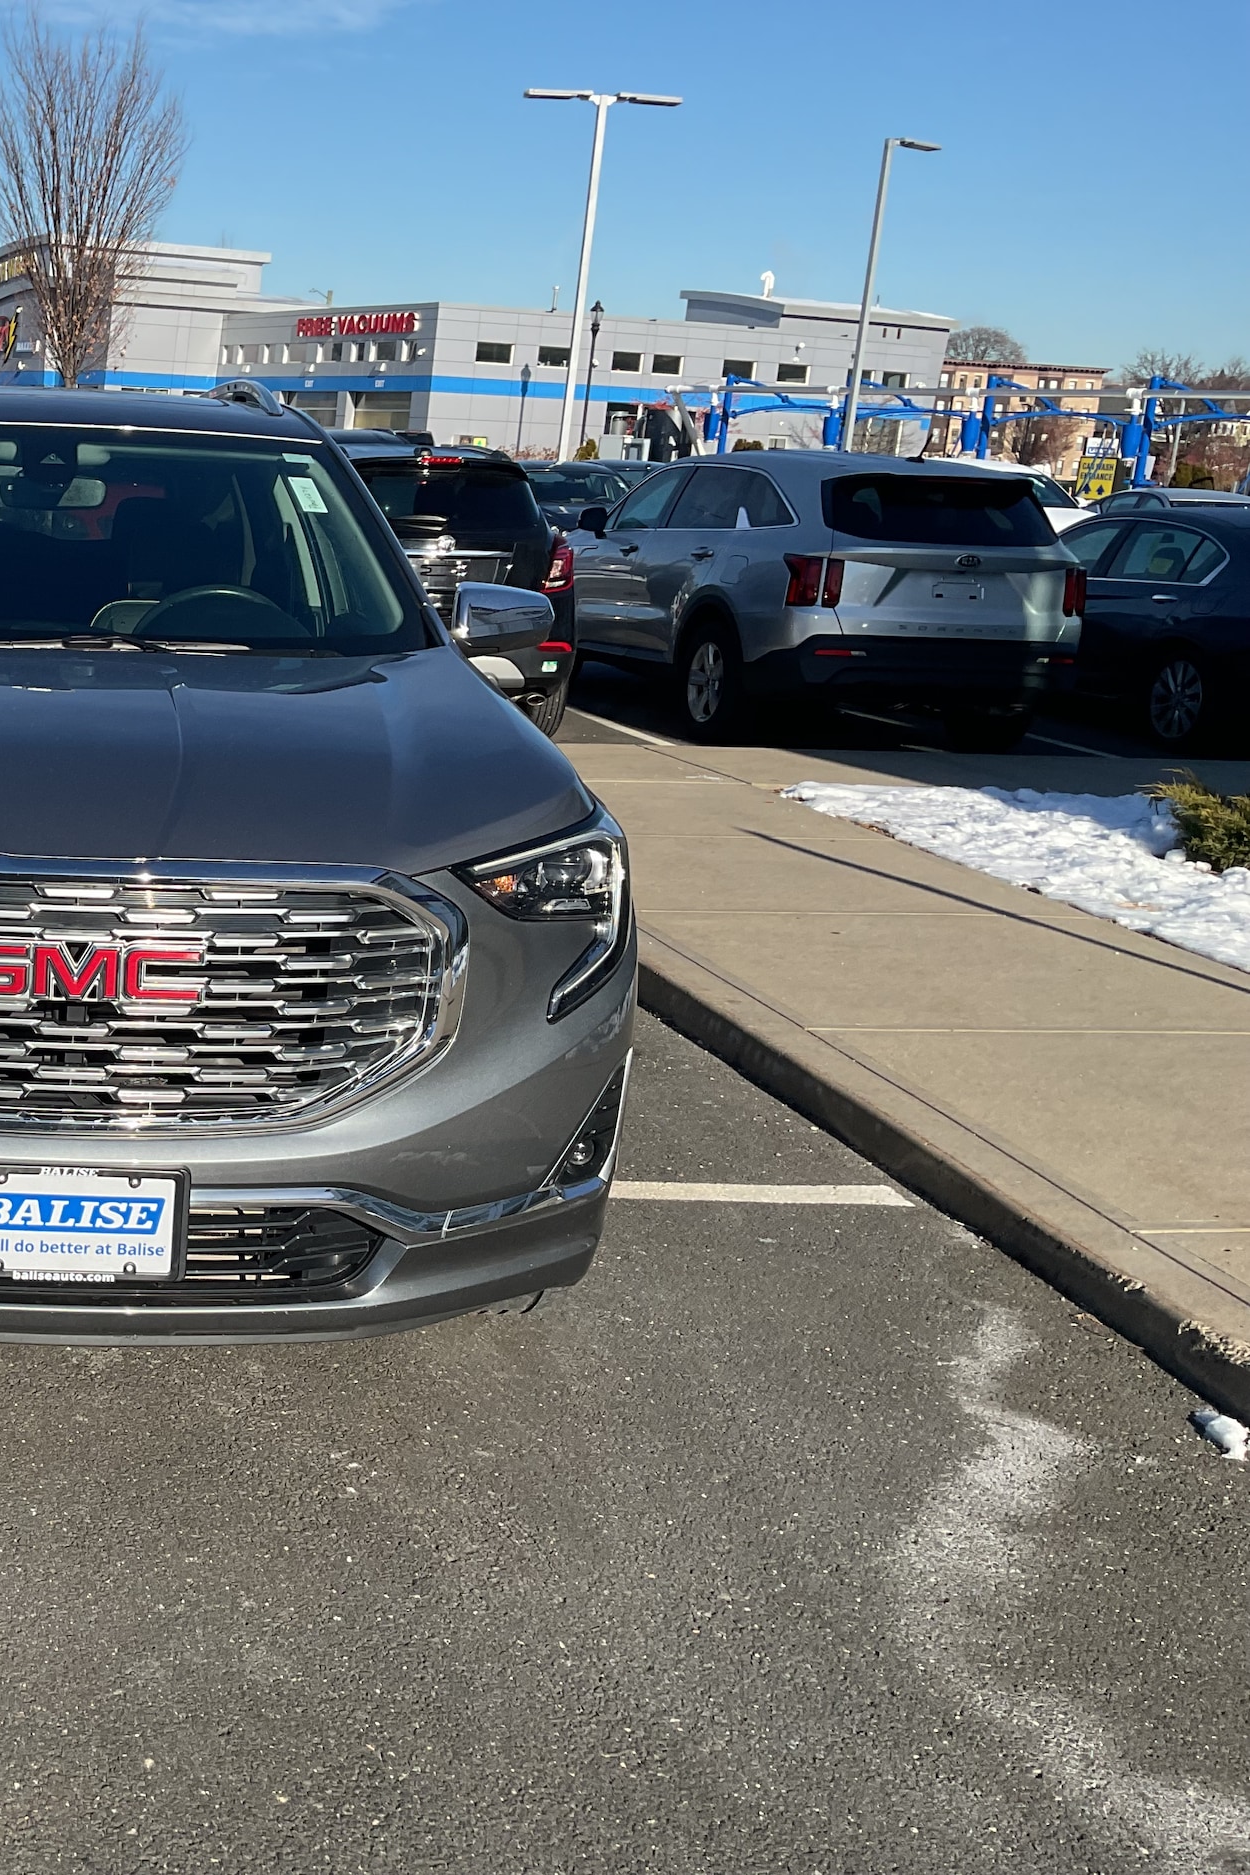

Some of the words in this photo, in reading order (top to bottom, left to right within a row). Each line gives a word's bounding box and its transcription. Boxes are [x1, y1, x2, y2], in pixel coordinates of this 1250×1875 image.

[297, 316, 337, 337] FREE
[338, 312, 421, 335] VACUUMS
[39, 1167, 100, 1178] BALISE
[14, 1239, 35, 1254] do
[40, 1240, 91, 1255] better
[95, 1242, 112, 1256] at
[117, 1243, 165, 1257] Balise
[12, 1269, 116, 1284] baliseauto.com
